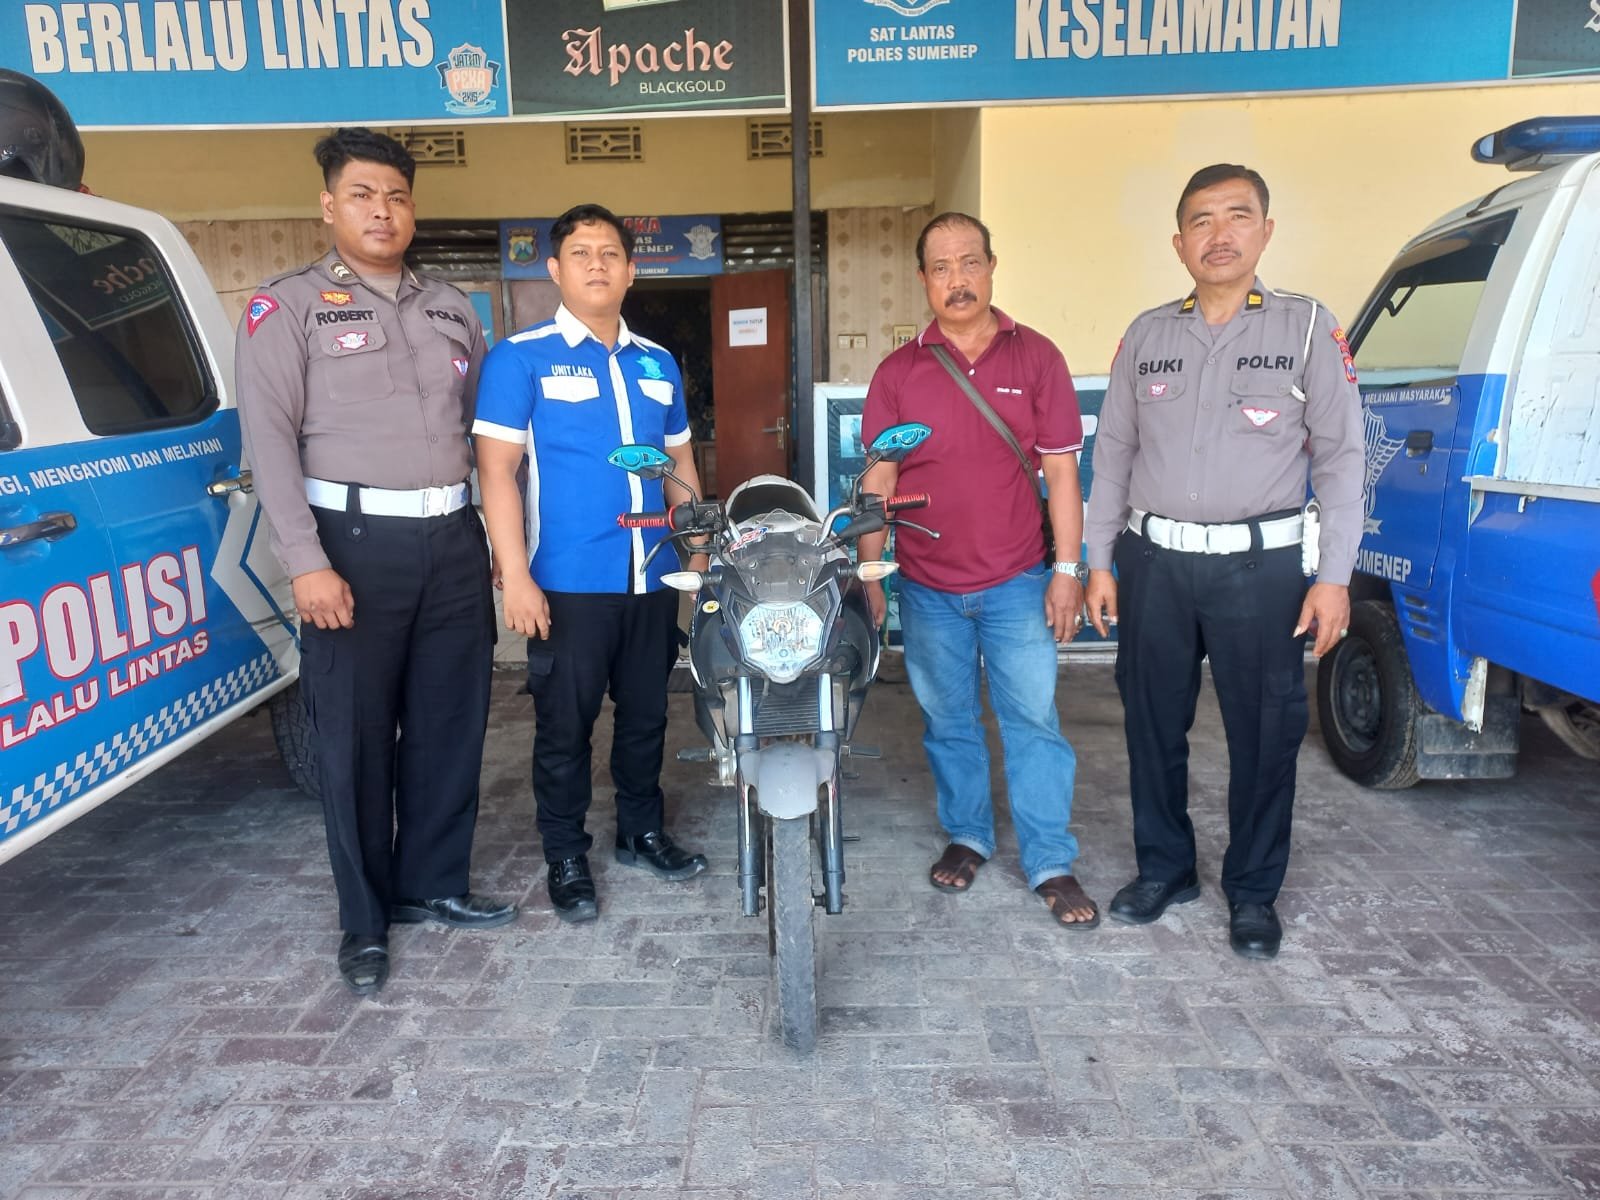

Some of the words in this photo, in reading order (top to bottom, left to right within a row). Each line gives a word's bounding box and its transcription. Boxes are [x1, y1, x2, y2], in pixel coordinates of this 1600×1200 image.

[25, 0, 249, 74] BERLALU
[258, 0, 435, 71] LINTAS
[870, 27, 896, 43] SAT
[901, 25, 955, 41] LANTAS
[1015, 0, 1341, 60] KESELAMATAN
[561, 26, 734, 87] Apache
[847, 47, 903, 63] POLRES
[907, 44, 978, 60] SUMENEP
[451, 69, 487, 90] PEKA
[639, 80, 726, 95] BLACKGOLD
[635, 236, 653, 244] AS
[315, 310, 375, 326] ROBERT
[551, 364, 571, 377] UNIT
[572, 365, 595, 378] LAKA
[1138, 358, 1183, 376] SUKI
[1236, 355, 1295, 371] POLRI
[1365, 391, 1398, 404] MELAYANI
[0, 475, 31, 496] GI,
[29, 456, 131, 490] MENGAYOMI
[133, 451, 163, 469] DAN
[163, 438, 224, 462] MELAYANI
[1355, 548, 1412, 584] UMENEP
[0, 545, 207, 706] POLISI
[0, 680, 101, 749] LALU
[108, 629, 211, 698] LINTAS
